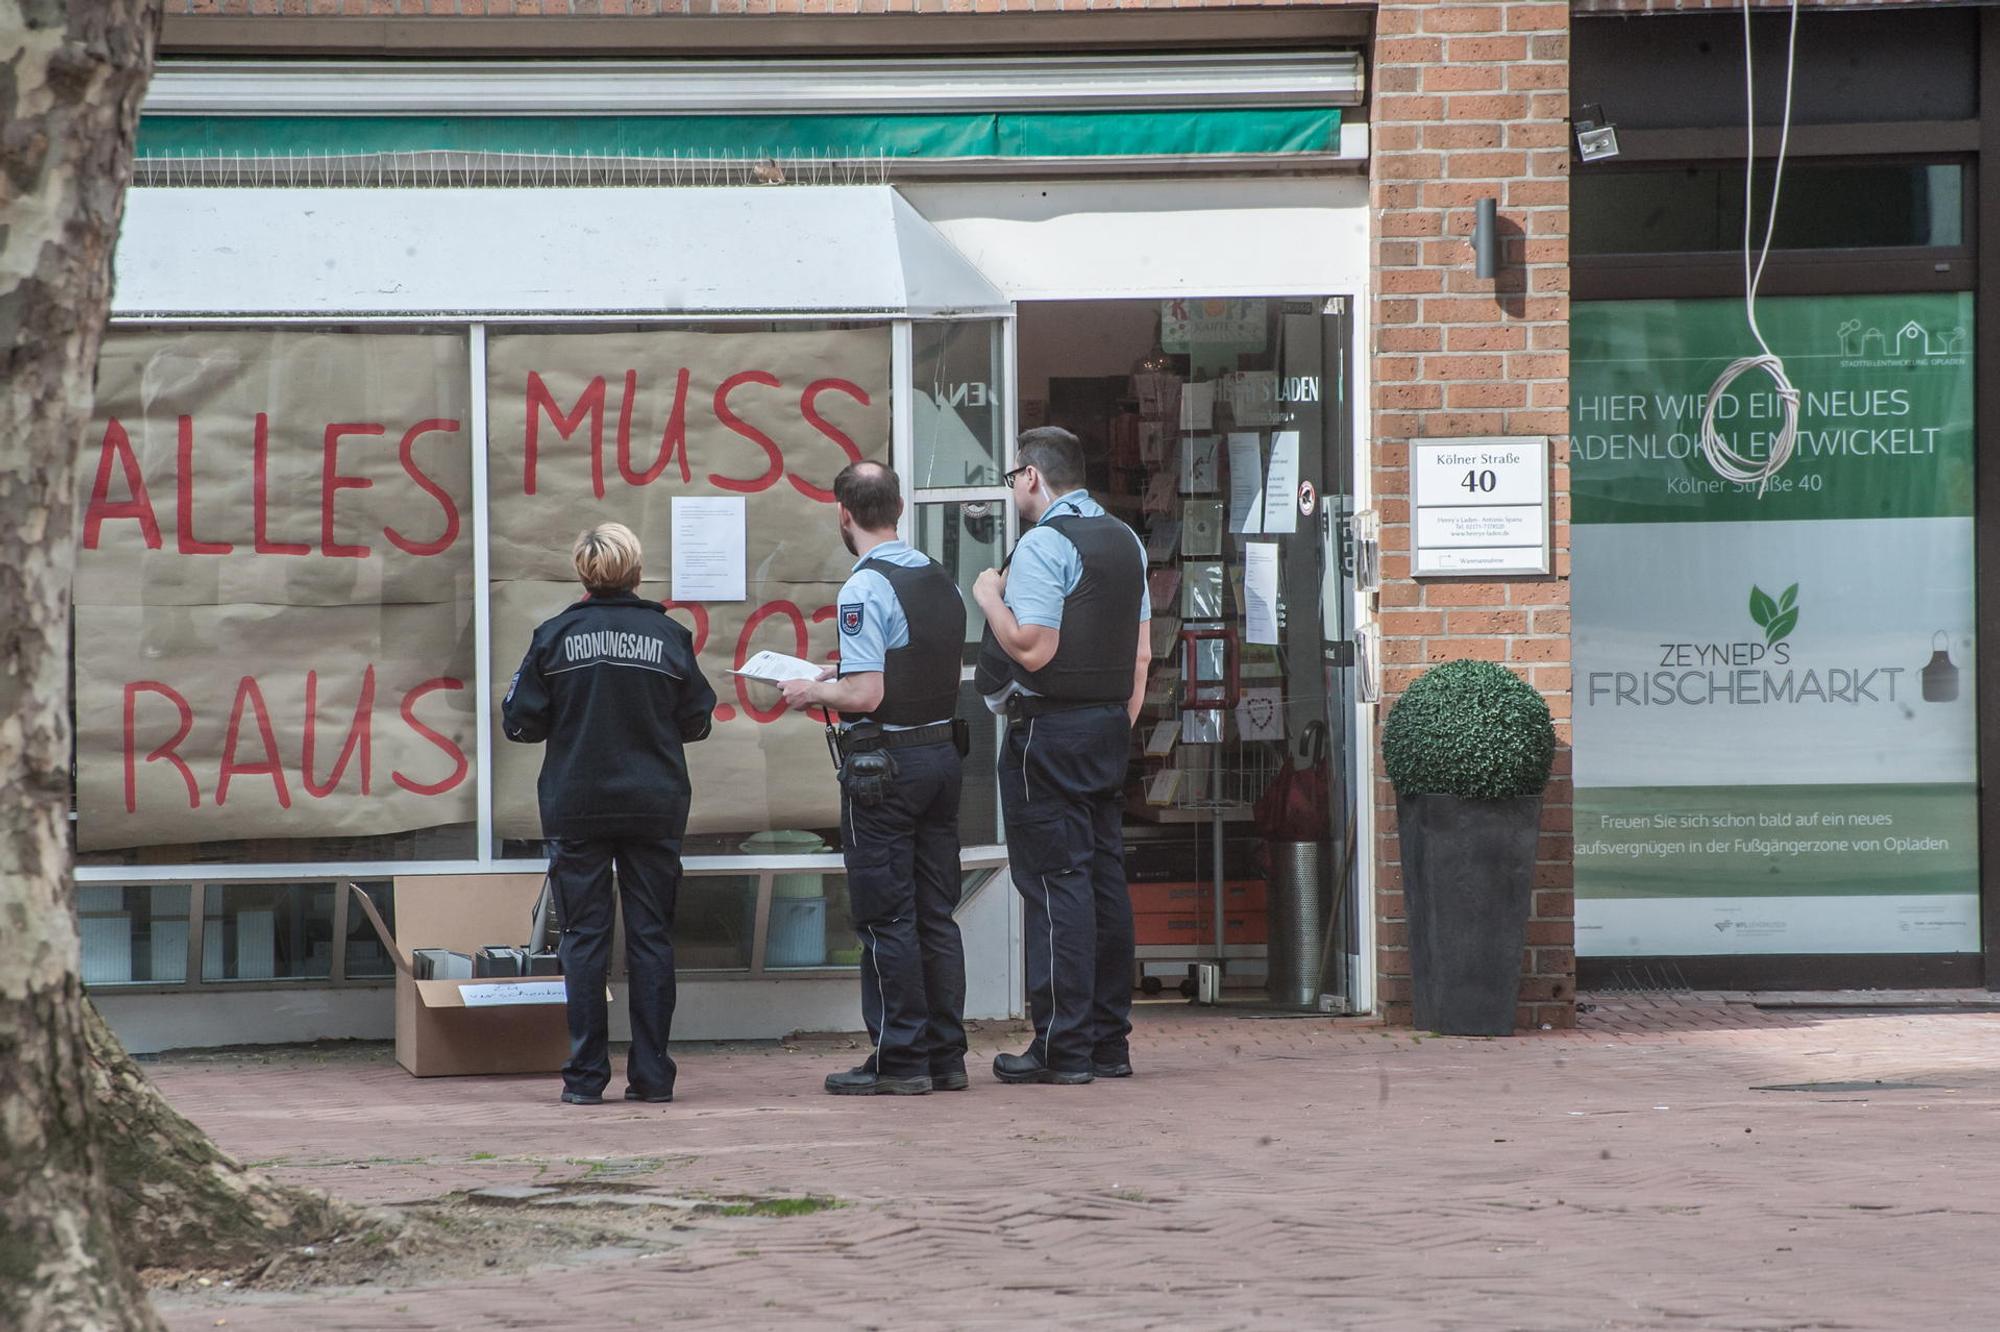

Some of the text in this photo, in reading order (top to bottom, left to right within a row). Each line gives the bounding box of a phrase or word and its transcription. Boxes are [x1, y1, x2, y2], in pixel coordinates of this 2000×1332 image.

[1275, 376, 1319, 402] LADEN
[1579, 395, 1647, 421] HIER
[1808, 389, 1910, 416] NEUES
[523, 367, 870, 503] MUSS
[1437, 452, 1520, 465] Kölner Straße
[83, 412, 460, 557] ALLES
[1461, 470, 1496, 493] 40
[1667, 477, 1726, 494] Kölner
[1798, 474, 1822, 491] 40
[564, 630, 664, 664] ORDNUNGSAMT
[1659, 642, 1790, 667] ZEYNEP'S
[1588, 667, 1905, 706] FRISCHEMARKT
[124, 664, 468, 813] RAUS
[1601, 811, 1893, 829] Freuen Sie sich schon bald auf ein neues
[1689, 839, 1701, 853] in
[1705, 839, 1731, 853] der
[1734, 838, 1849, 856] Fußgängerzone
[1851, 840, 1880, 851] von
[1883, 836, 1949, 854] Opladen
